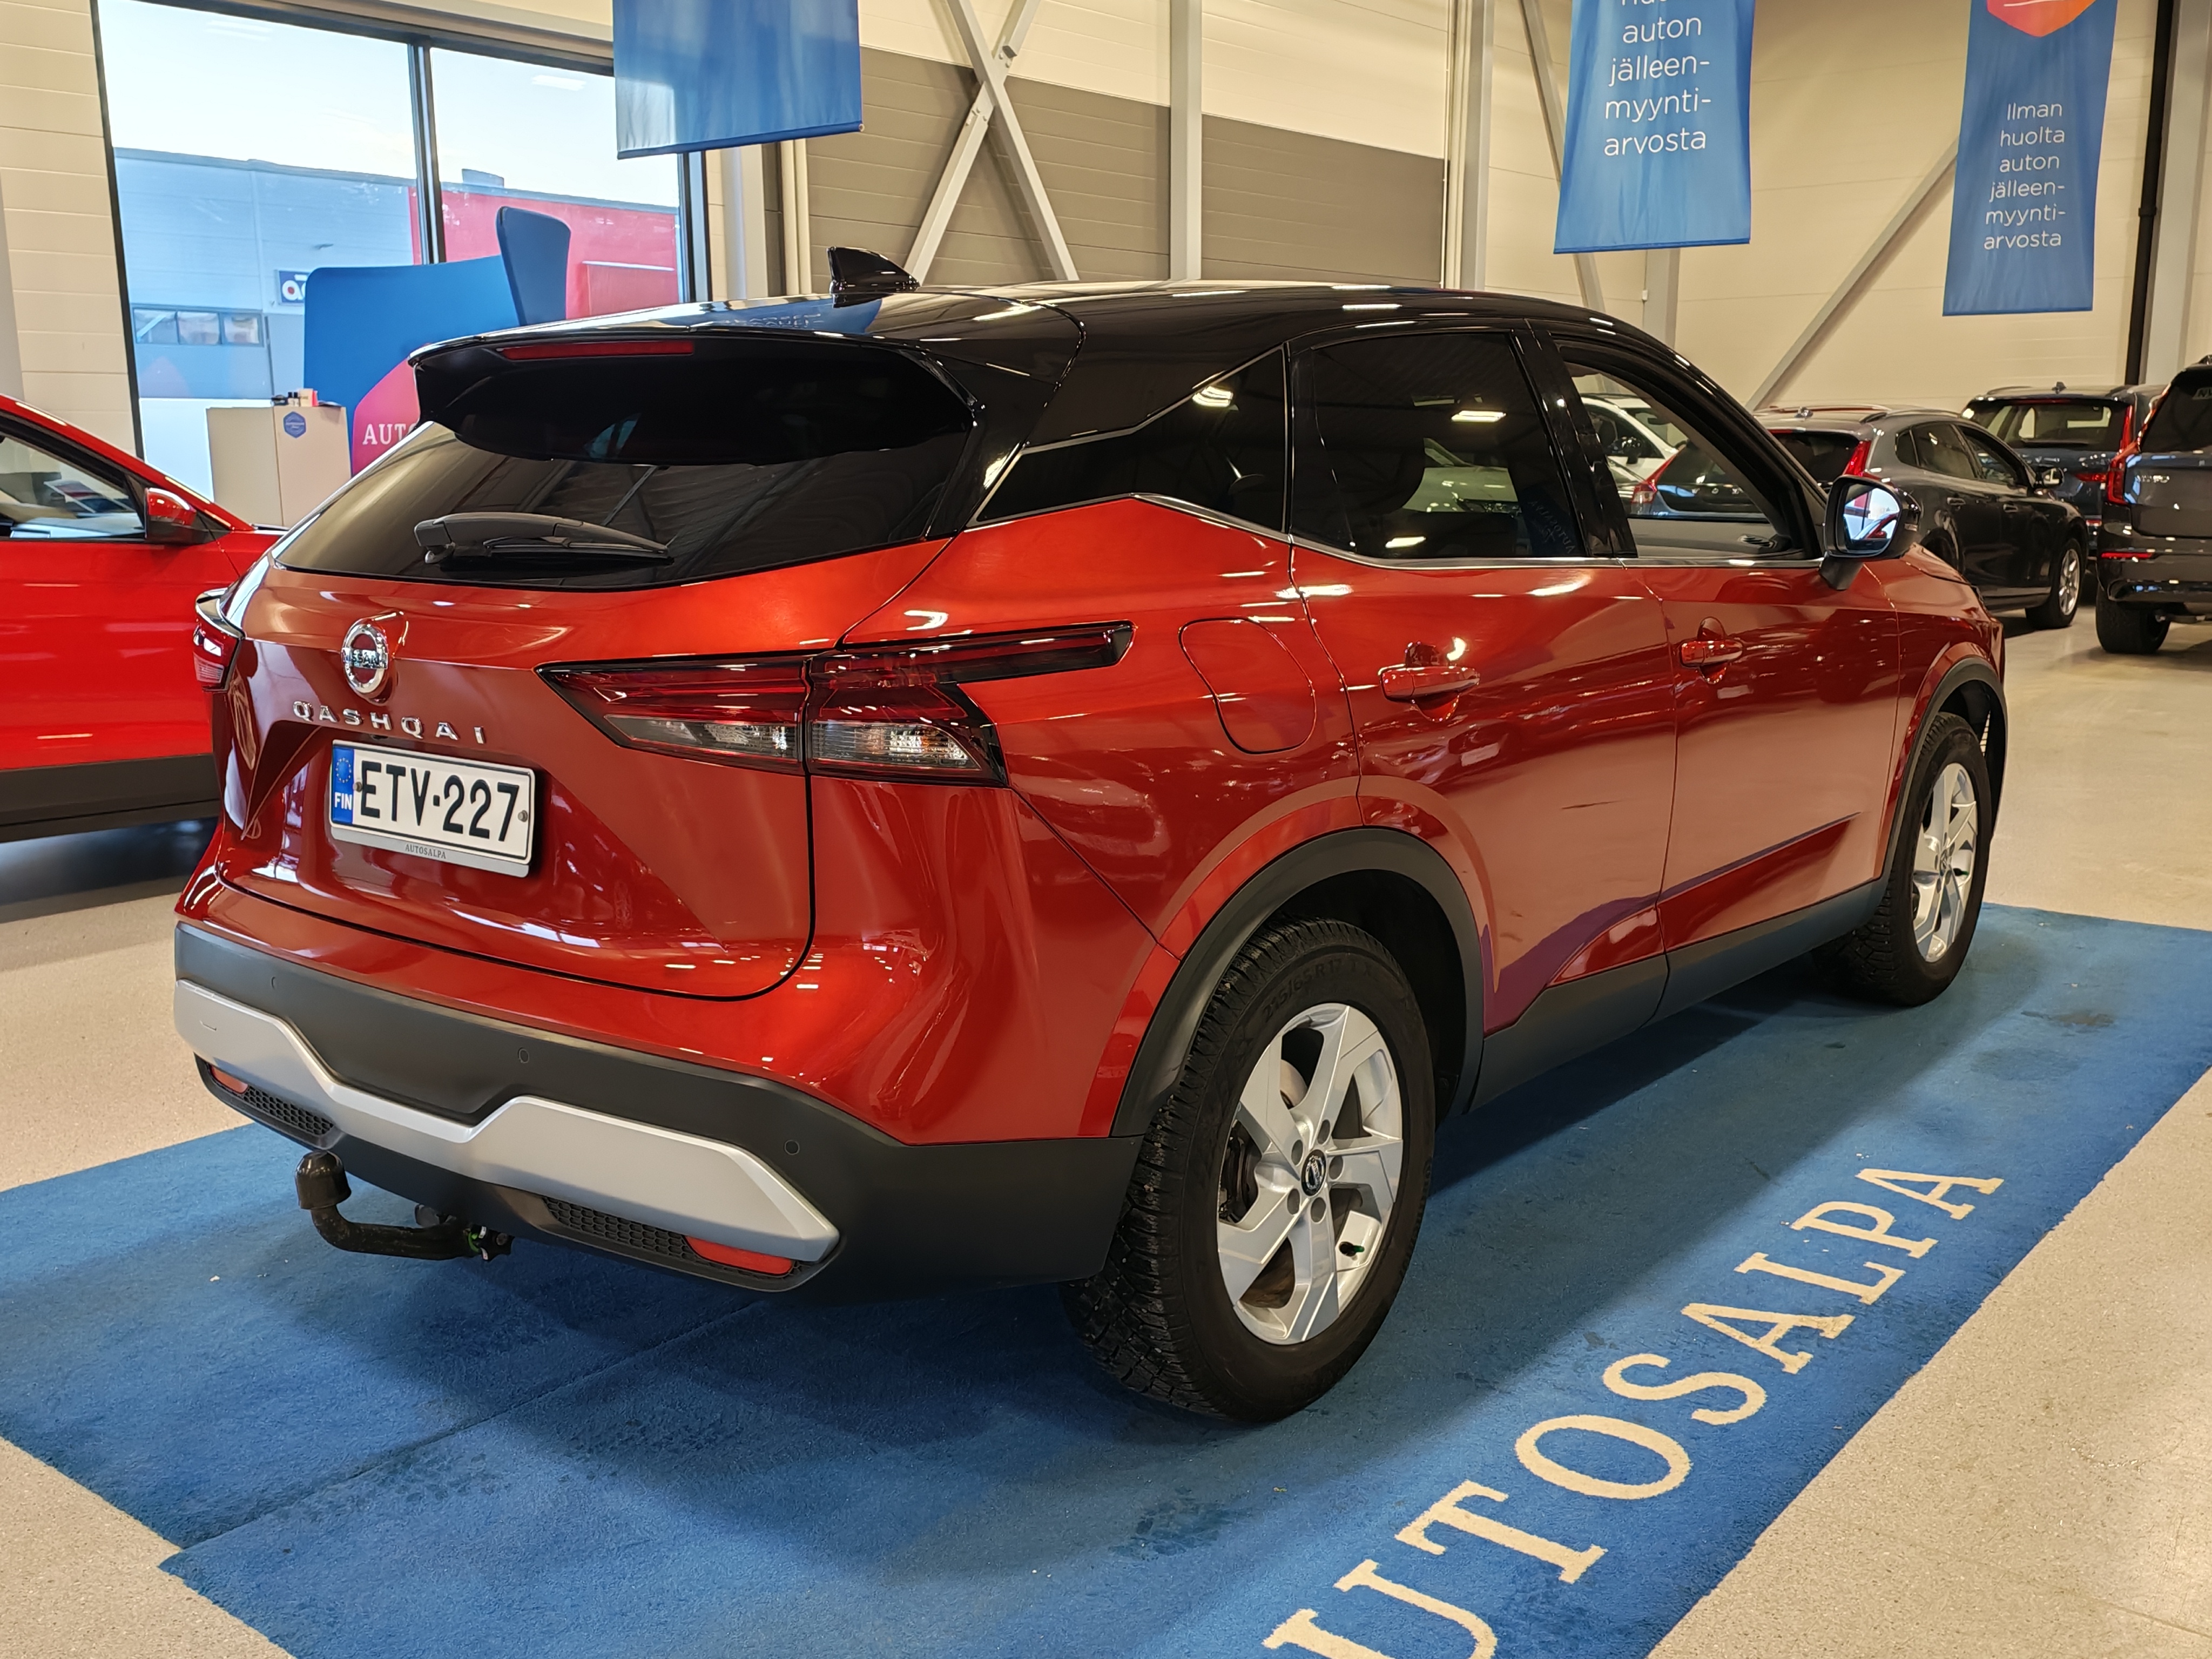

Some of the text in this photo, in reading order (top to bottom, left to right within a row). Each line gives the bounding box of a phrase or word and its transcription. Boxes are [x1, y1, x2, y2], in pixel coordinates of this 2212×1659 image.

[1622, 17, 1702, 44] auton
[1608, 55, 1710, 87] jälleen-
[1605, 87, 1711, 123] myynti-
[2007, 102, 2063, 120] Ilman
[1604, 127, 1707, 157] arvosta
[2000, 126, 2065, 147] huolta
[1999, 154, 2060, 173] auton
[1989, 179, 2065, 203] jälleen-
[1985, 204, 2066, 226] myynti-
[1984, 230, 2062, 250] arvosta
[362, 423, 416, 445] AUT
[341, 648, 381, 666] NISSAN
[292, 700, 487, 744] QASHQAI
[334, 792, 353, 811] FIN
[405, 844, 447, 860] AUTOSALPA
